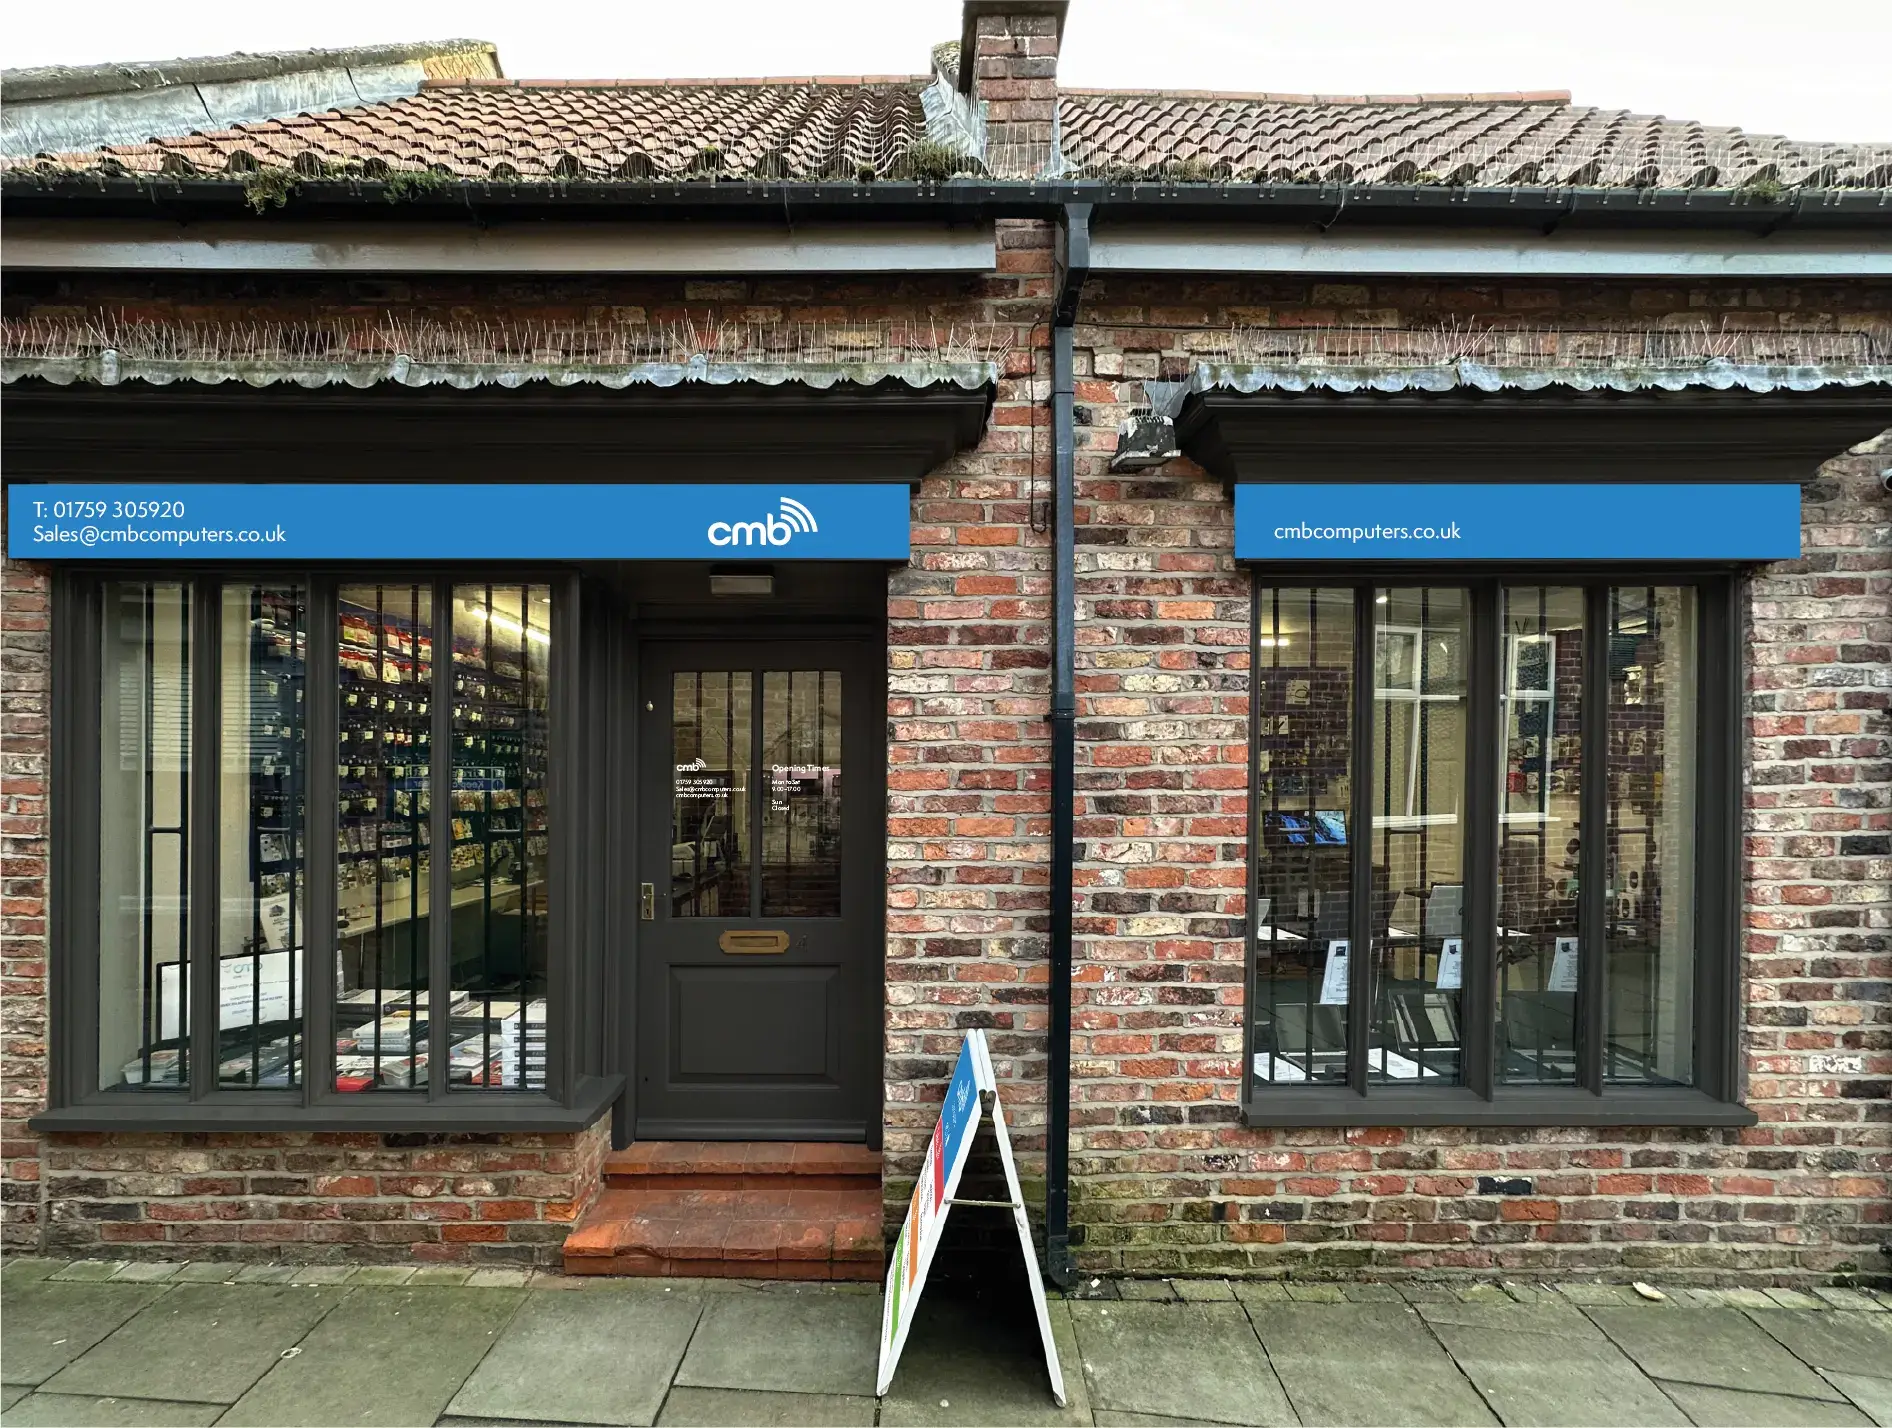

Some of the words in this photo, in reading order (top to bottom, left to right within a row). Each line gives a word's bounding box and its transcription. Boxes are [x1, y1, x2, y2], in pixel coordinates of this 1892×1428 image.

[33, 501, 48, 518] T:
[54, 501, 107, 518] 01759
[112, 501, 185, 518] 305920
[33, 525, 287, 546] Sales@cmbcomputers.co.uk
[707, 512, 792, 546] cmb
[1274, 521, 1461, 543] cmbcomputers.co.uk
[676, 762, 699, 772] cmb
[772, 764, 806, 774] Opening
[807, 764, 830, 772] Times
